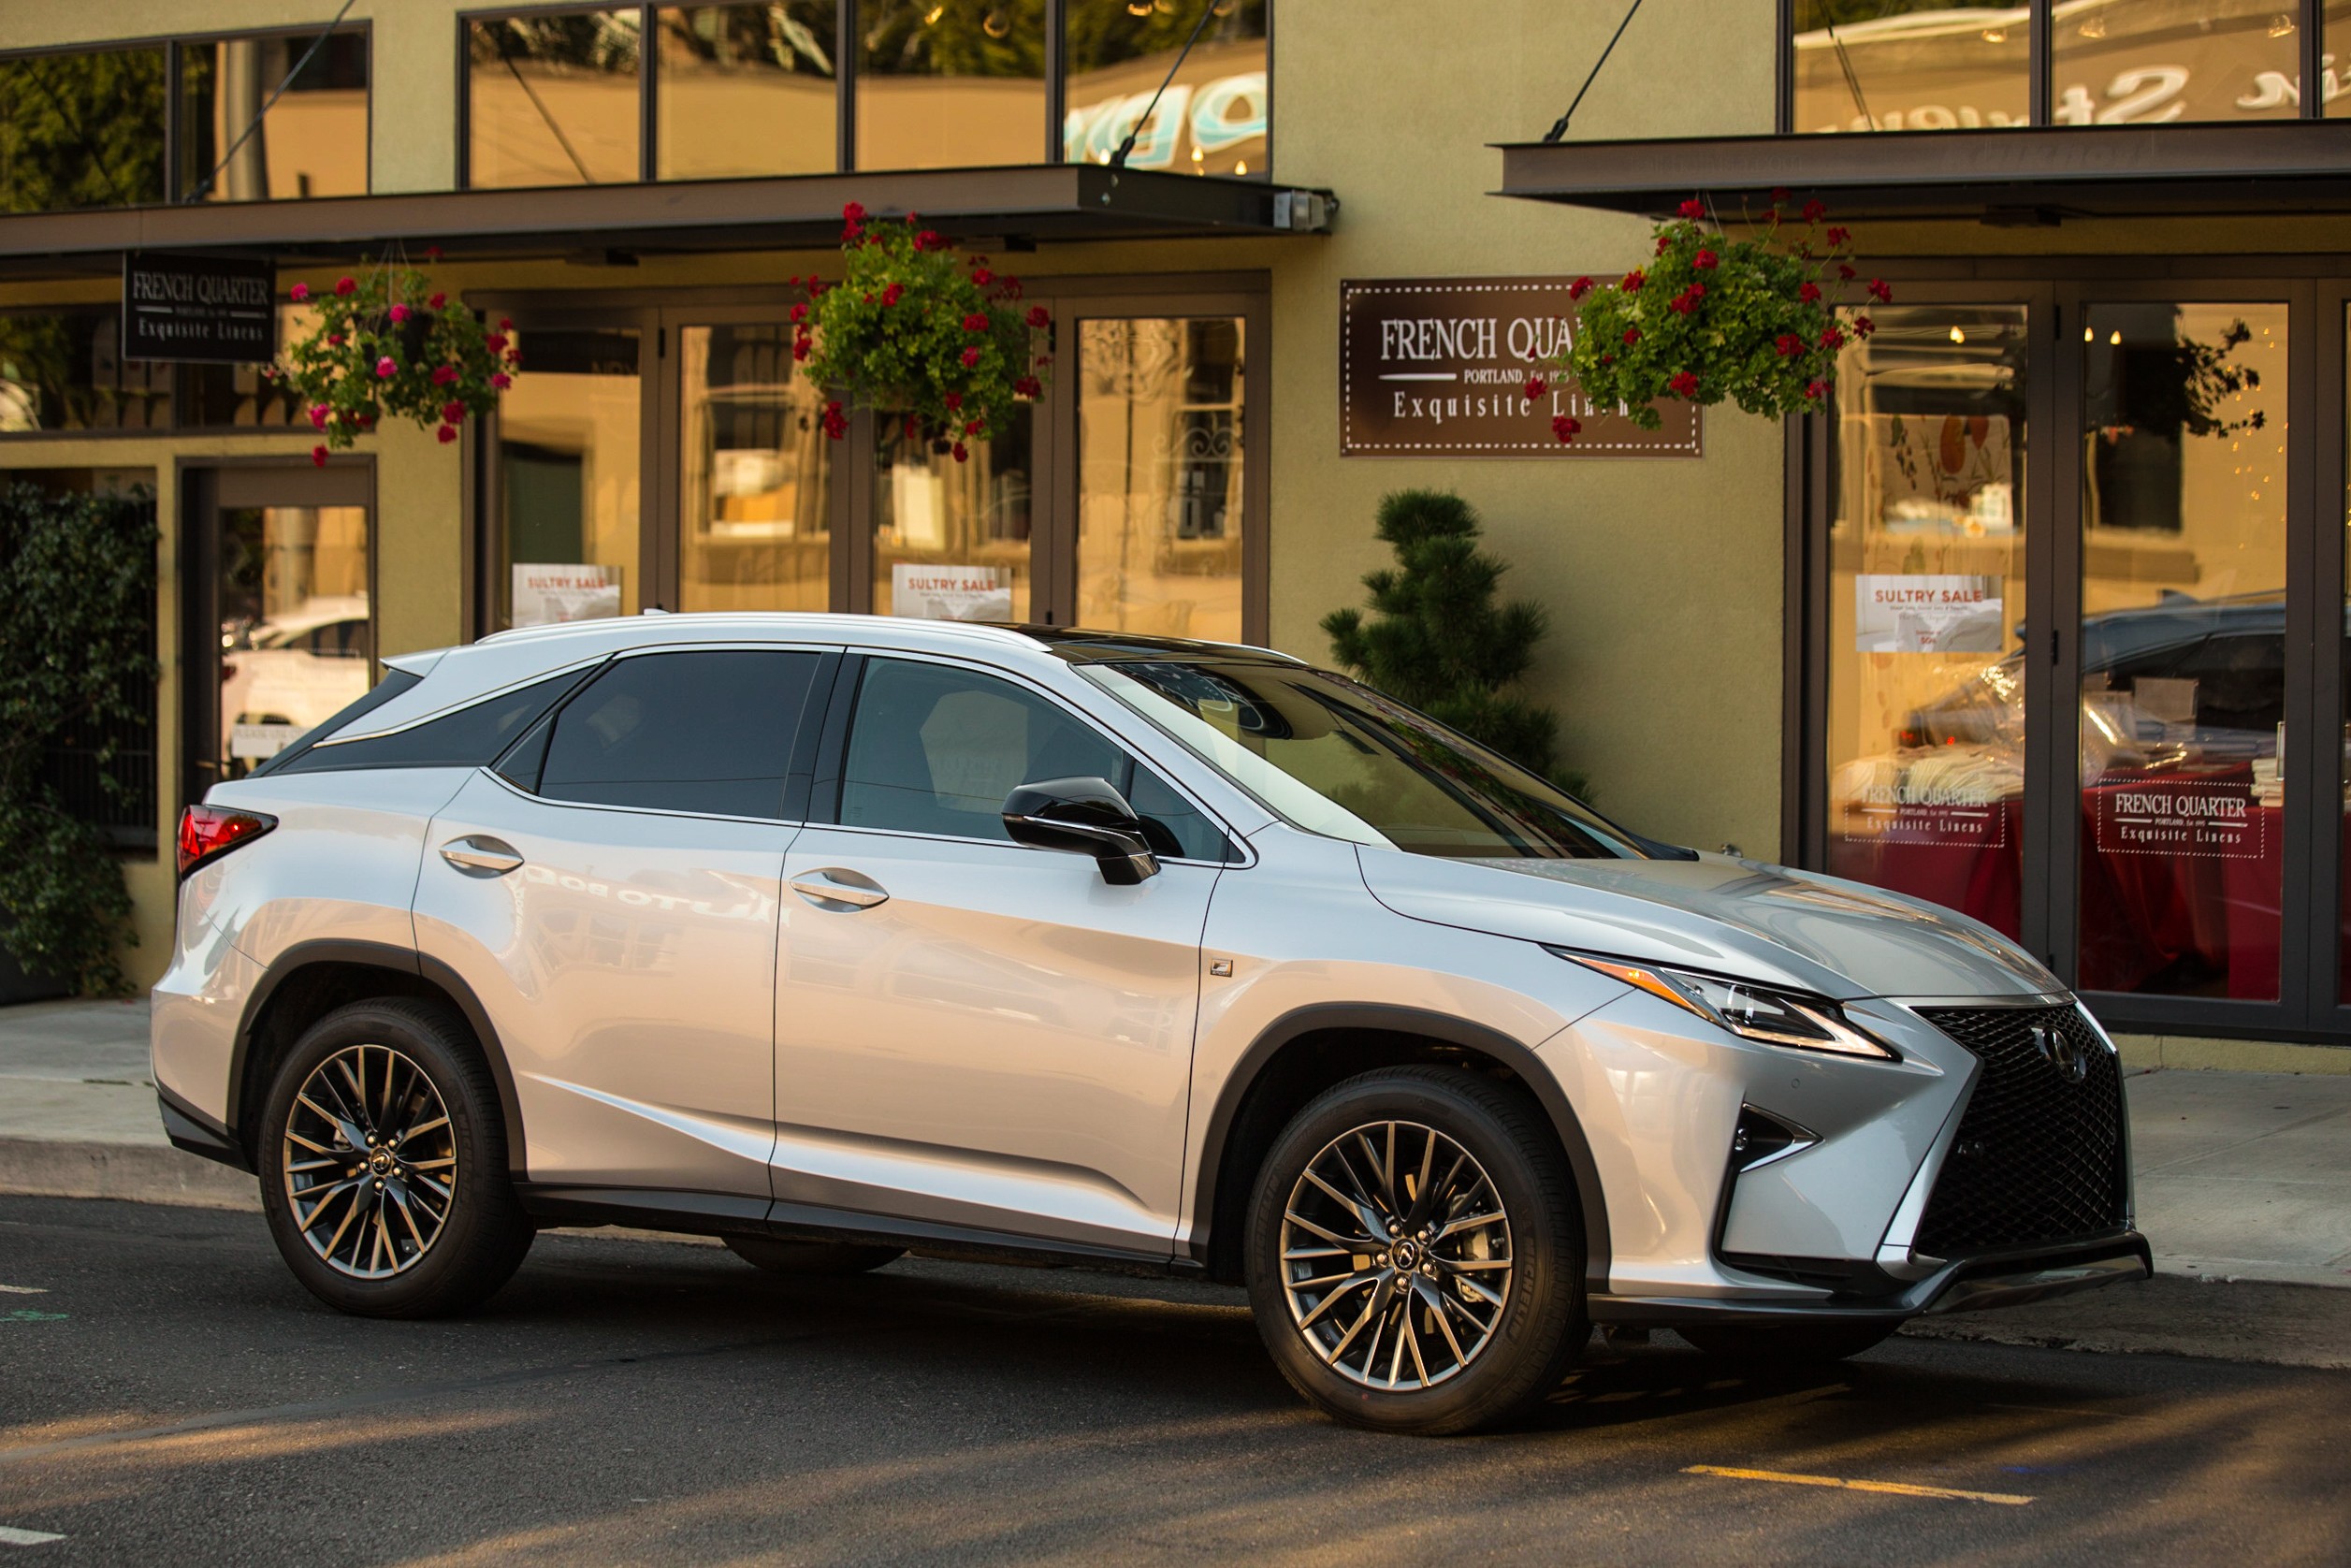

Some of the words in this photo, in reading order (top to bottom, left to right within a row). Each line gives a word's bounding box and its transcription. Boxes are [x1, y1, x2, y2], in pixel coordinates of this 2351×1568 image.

[133, 270, 194, 301] FRENCH
[197, 274, 268, 306] QUARTER
[138, 317, 210, 341] Exquisite
[1381, 317, 1497, 360] FRENCH
[1464, 369, 1527, 385] PORTLAND,
[1394, 391, 1531, 425] Exquisite
[528, 576, 570, 589] SULTRY
[575, 576, 606, 589] SALE
[908, 577, 957, 590] SULTRY
[962, 579, 995, 592] SALE
[1875, 589, 1936, 603] SULTRY
[1941, 589, 1983, 603] SALE
[1861, 785, 1916, 806] FRENCH
[1920, 788, 1988, 808] QUARTER
[2115, 793, 2171, 815] FRENCH
[2176, 795, 2247, 818] QUARTER
[1866, 816, 1932, 832] Exquisite
[1939, 819, 1983, 833] Linens
[2121, 826, 2188, 843] Exquisite
[2197, 829, 2242, 844] Linens
[1255, 1173, 1282, 1275] MICHELIN
[1507, 1235, 1536, 1340] MICHELIN
